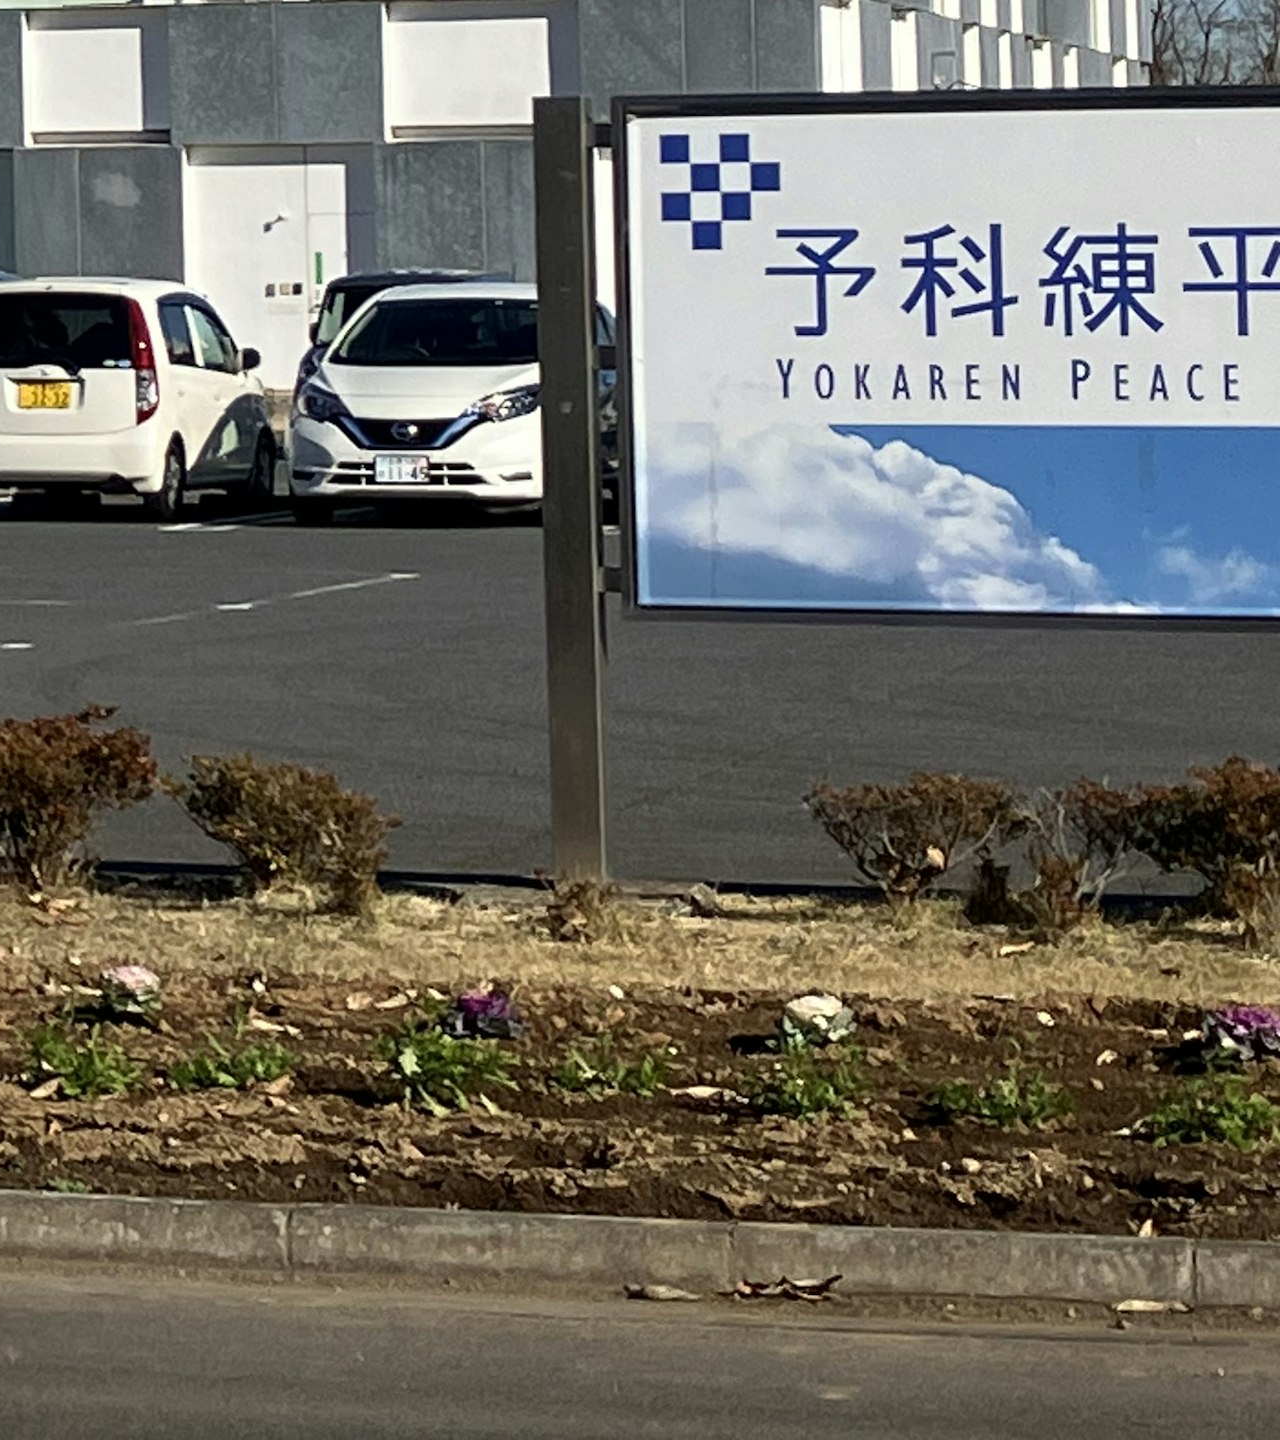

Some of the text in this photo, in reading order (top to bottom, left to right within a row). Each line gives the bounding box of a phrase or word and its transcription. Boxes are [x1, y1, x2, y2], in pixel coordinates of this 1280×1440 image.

[765, 223, 1280, 337] 予科練平
[775, 358, 1239, 402] YOKAREN PEACE
